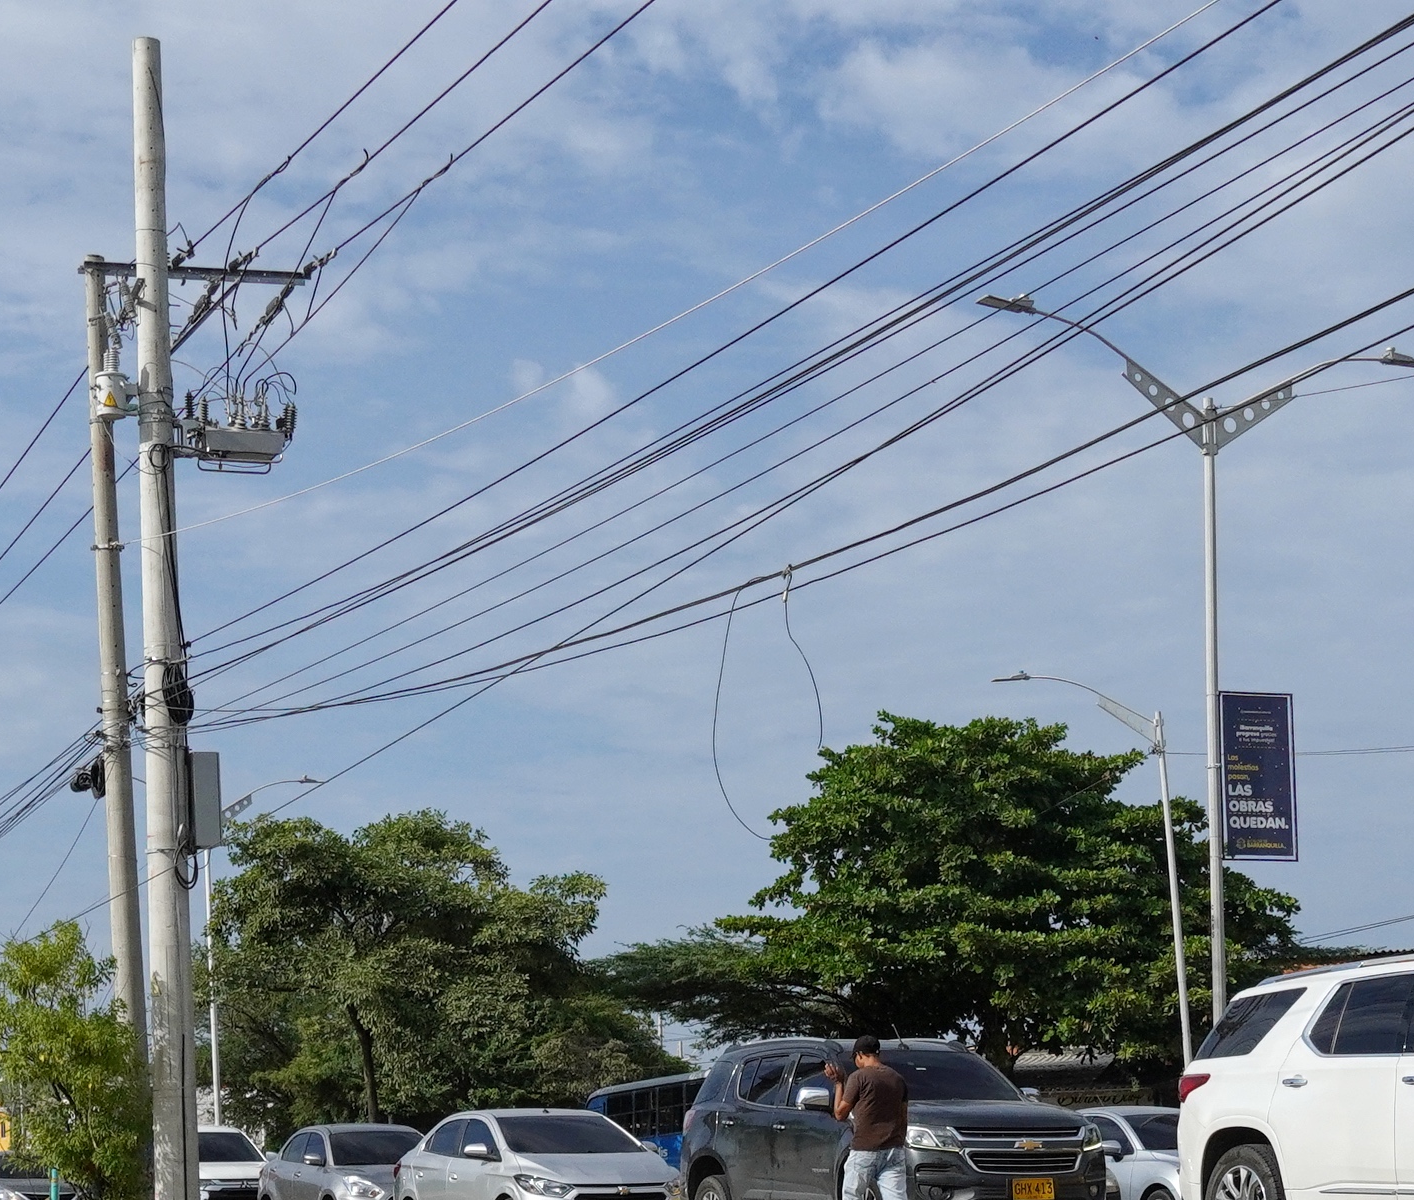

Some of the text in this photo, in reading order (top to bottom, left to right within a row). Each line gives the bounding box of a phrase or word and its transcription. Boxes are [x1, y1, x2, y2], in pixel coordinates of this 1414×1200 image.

[1228, 784, 1253, 796] LAS
[1228, 801, 1274, 813] OBRAS
[1229, 816, 1289, 829] QUEDAN.
[1014, 1182, 1053, 1195] GHX 413
